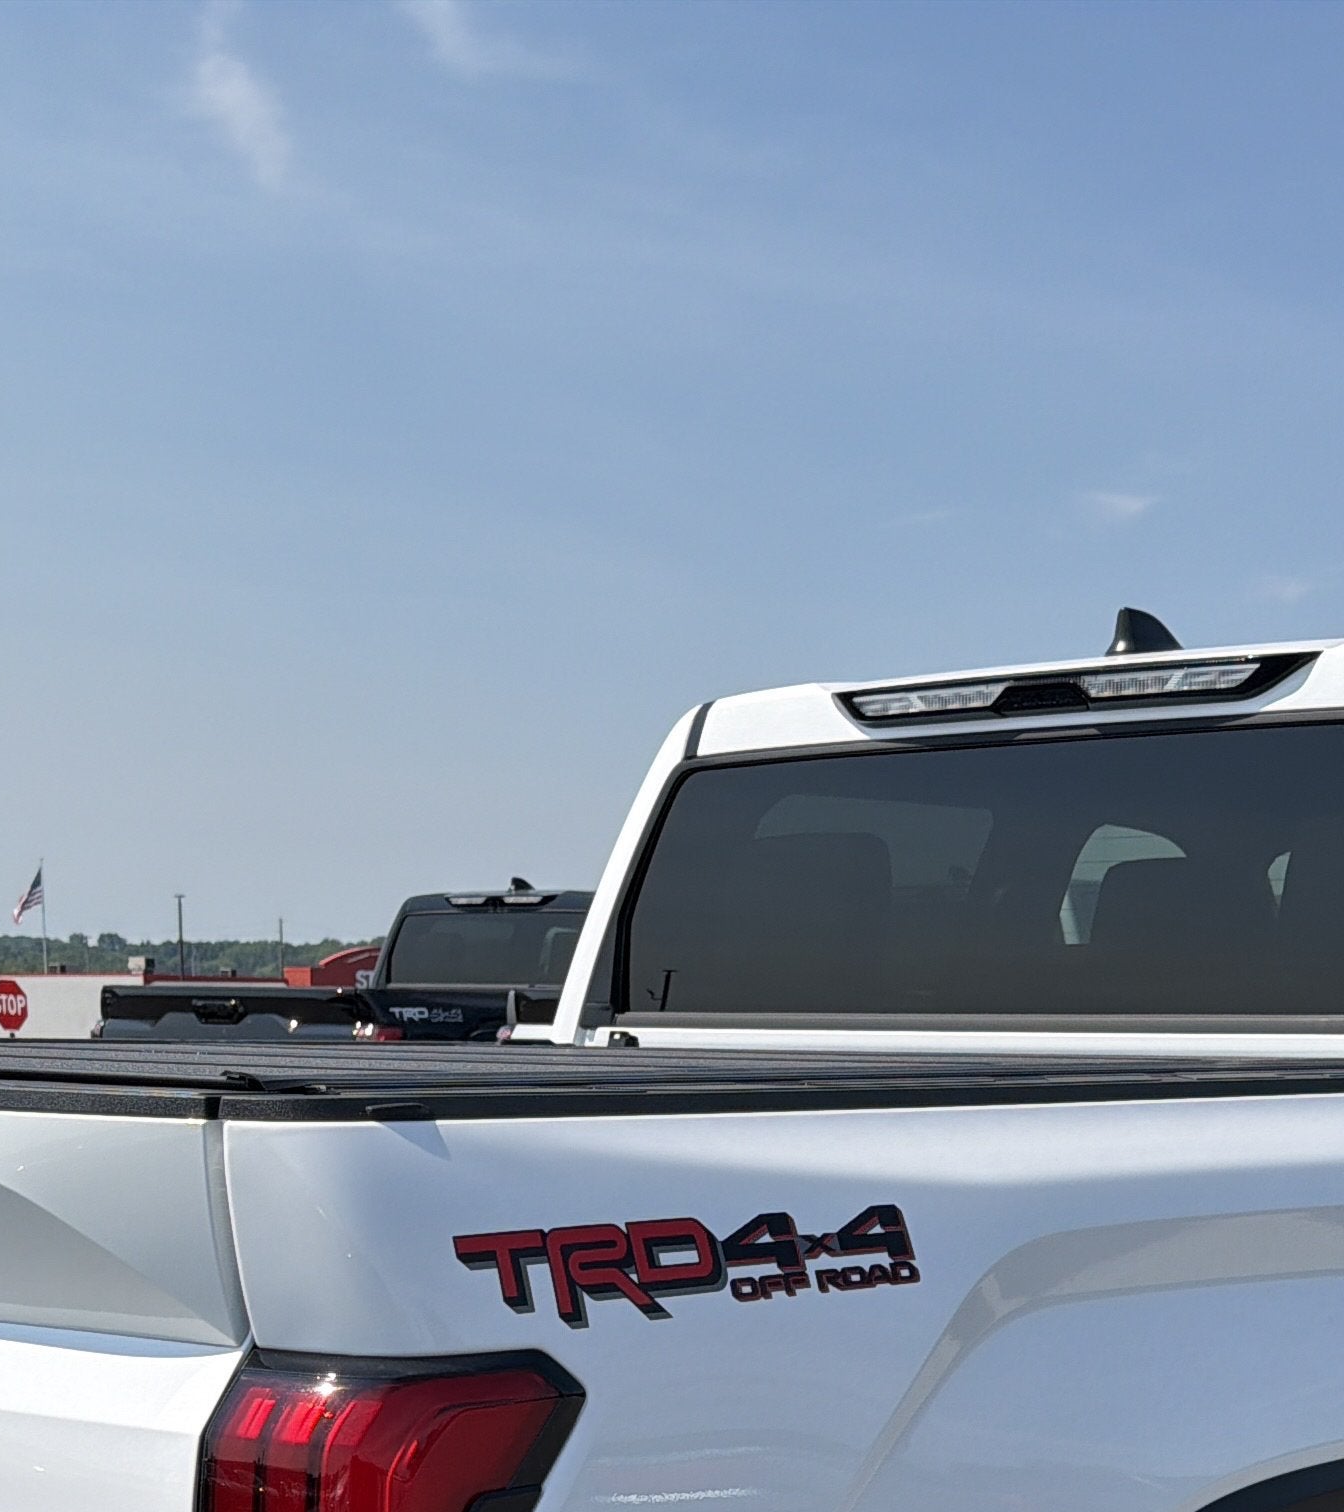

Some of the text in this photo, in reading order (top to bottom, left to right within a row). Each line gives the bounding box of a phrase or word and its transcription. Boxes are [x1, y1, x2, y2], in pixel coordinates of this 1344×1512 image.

[389, 1007, 429, 1022] TRD
[453, 1217, 729, 1329] TRD
[730, 1260, 921, 1302] OFF ROAD
